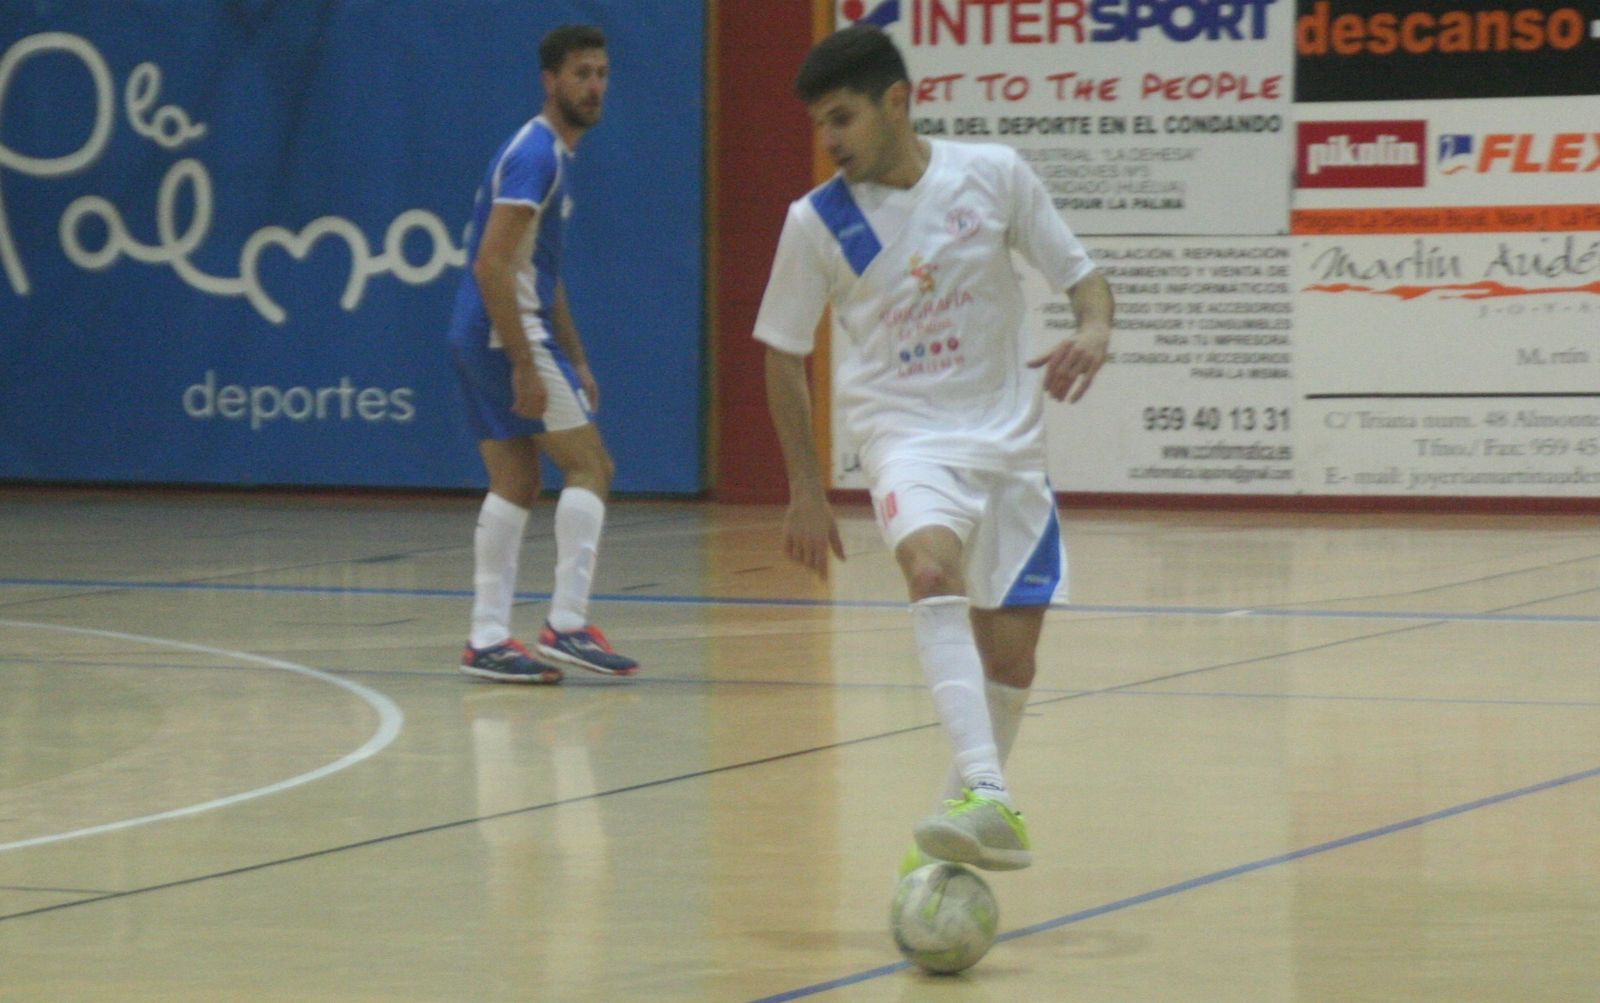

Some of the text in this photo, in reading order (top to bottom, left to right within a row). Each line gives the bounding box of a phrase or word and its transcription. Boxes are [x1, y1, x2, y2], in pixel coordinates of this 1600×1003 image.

[911, 0, 1276, 46] INTERSPORT
[1296, 0, 1585, 55] descanso
[125, 61, 207, 148] la
[912, 72, 964, 106] RT
[975, 71, 1030, 101] TO
[1142, 71, 1283, 100] PEOPLE
[953, 116, 991, 136] DEL
[998, 116, 1093, 136] DEPORTE
[1100, 116, 1127, 135] EN
[1133, 115, 1158, 135] EL
[1164, 113, 1282, 135] CONDANDO
[1306, 134, 1420, 175] pikolin
[1310, 239, 1461, 280] Martín
[182, 369, 417, 431] deportes
[1143, 406, 1291, 432] 959 40 13 31
